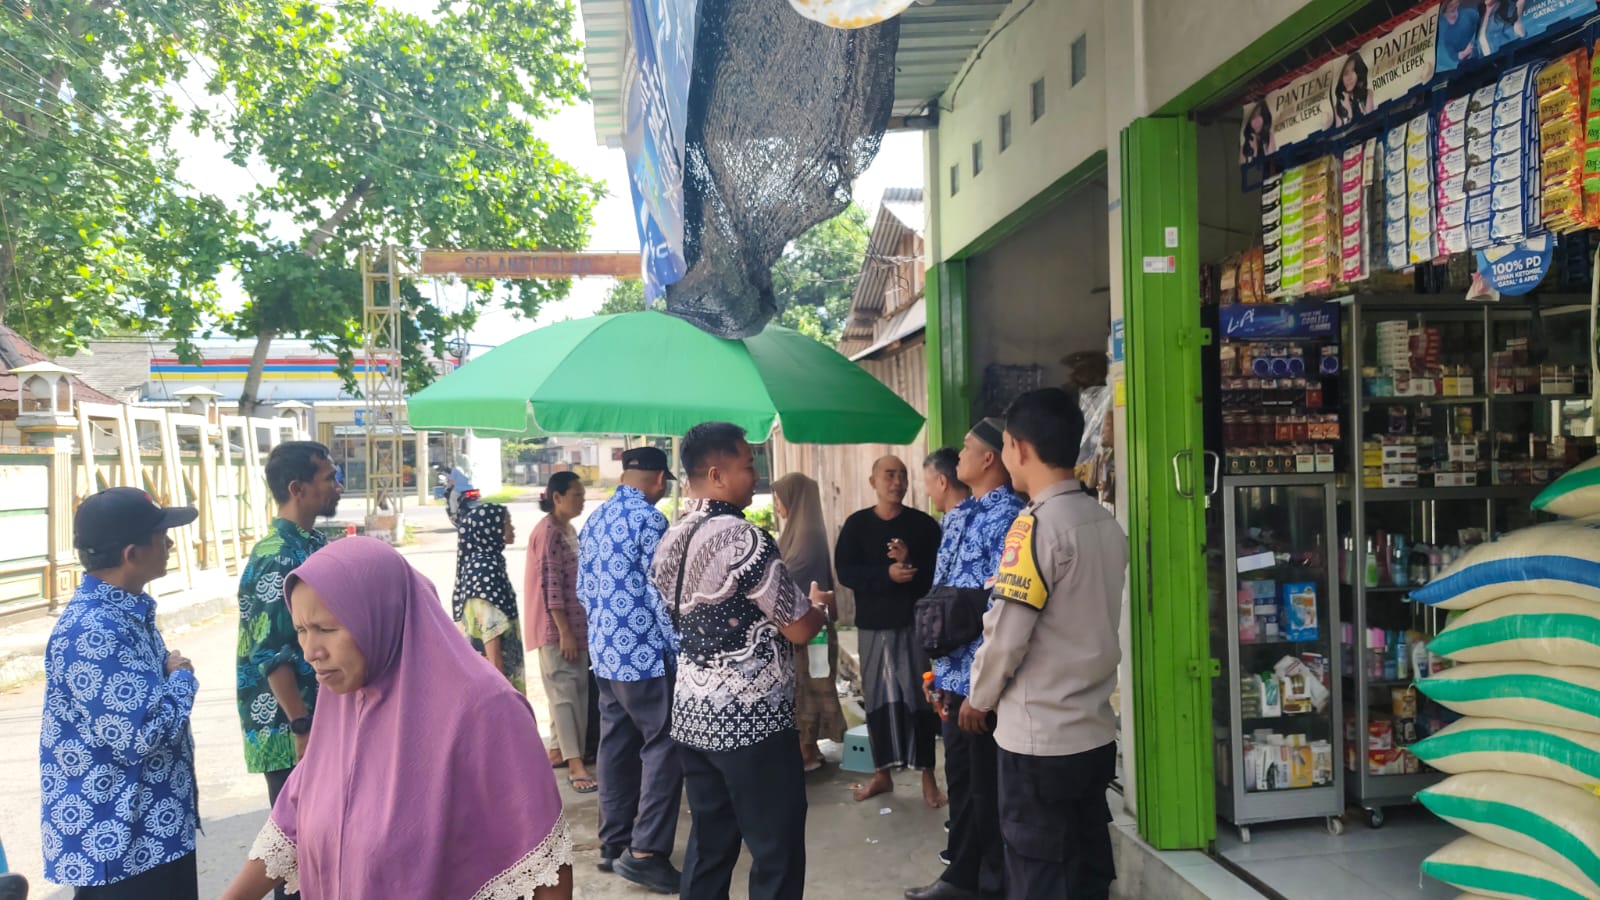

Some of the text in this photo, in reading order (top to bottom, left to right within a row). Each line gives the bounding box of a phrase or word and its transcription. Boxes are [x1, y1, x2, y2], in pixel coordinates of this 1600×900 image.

[1373, 13, 1437, 66] PANTENE
[1276, 70, 1332, 112] PANTENE
[1372, 68, 1401, 91] RONTOK,
[1402, 53, 1425, 75] LEPEK
[1300, 104, 1322, 121] LEPEK
[1491, 255, 1541, 275] 100% PD
